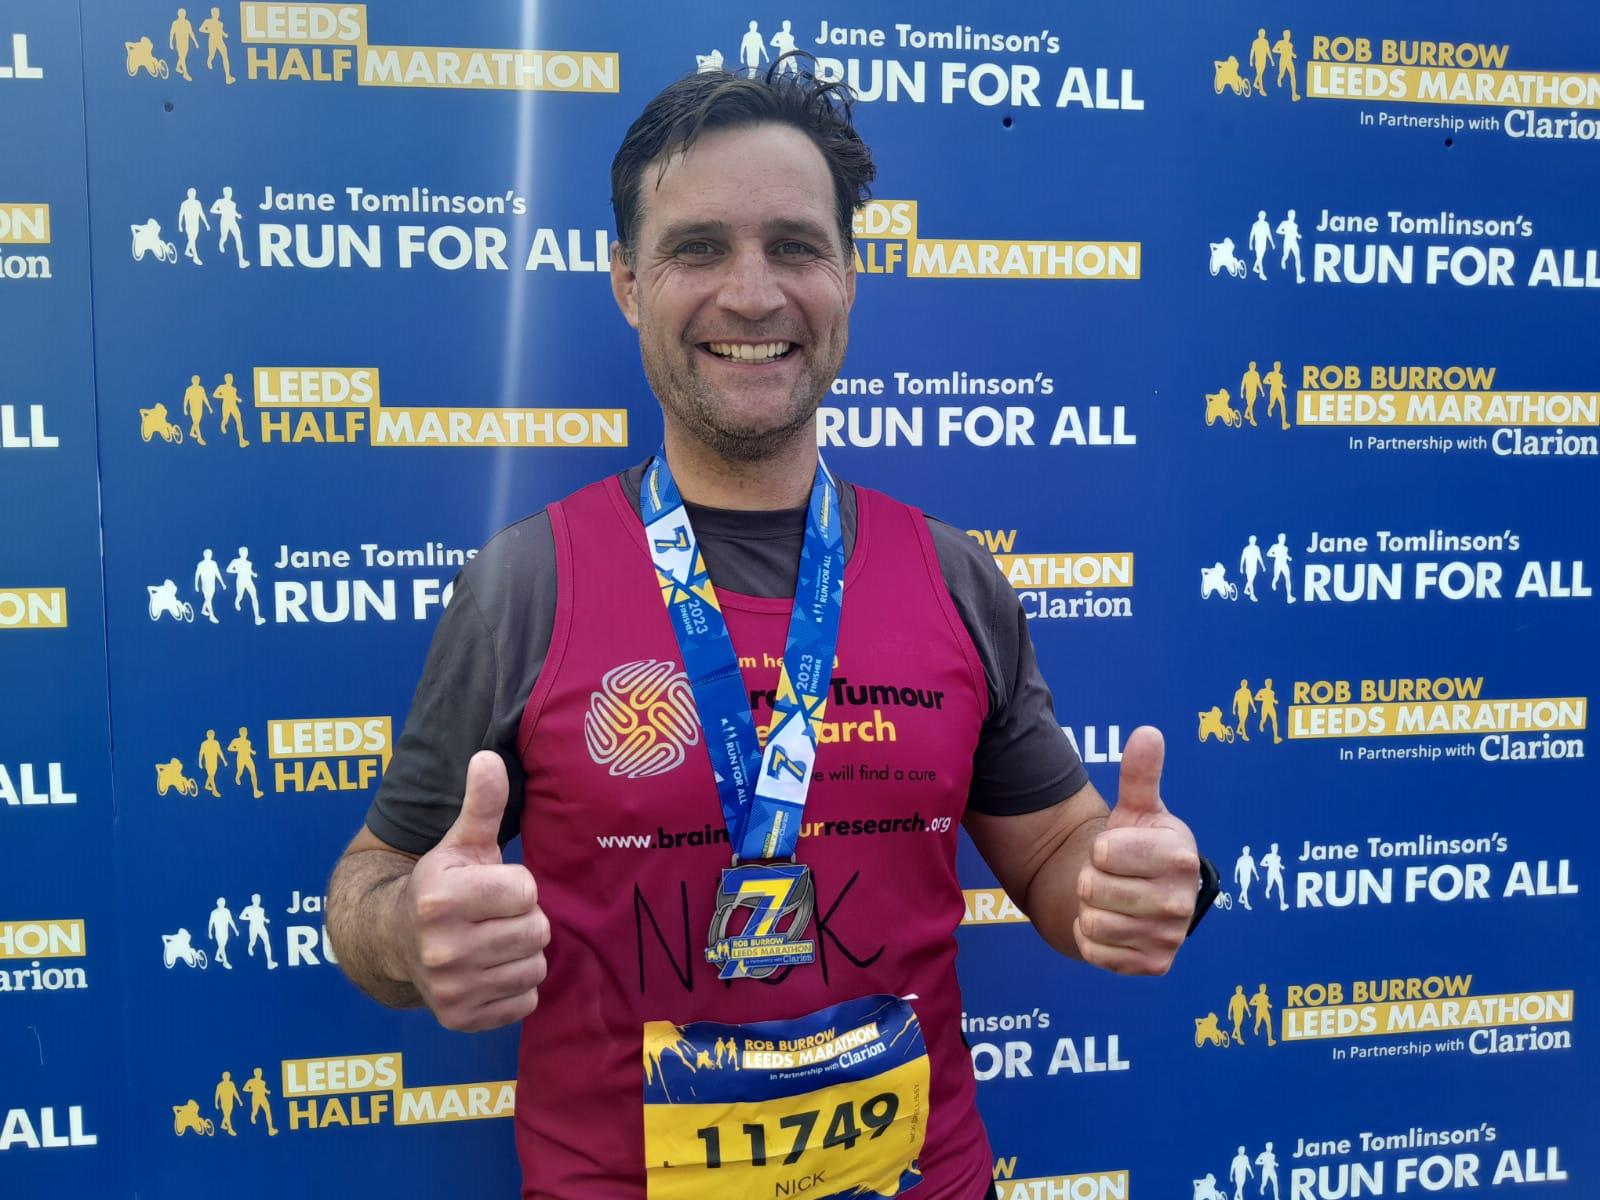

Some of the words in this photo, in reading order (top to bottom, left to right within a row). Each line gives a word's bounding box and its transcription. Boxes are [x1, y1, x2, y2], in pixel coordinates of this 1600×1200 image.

[246, 4, 360, 40] LEEDS
[815, 21, 885, 46] Jane
[896, 24, 1059, 53] Tomlinson's
[1313, 36, 1371, 62] ROB
[1382, 40, 1508, 68] BURROW
[248, 48, 351, 81] HALF
[363, 51, 614, 89] MARATHON
[815, 58, 925, 102] RUN
[942, 63, 1040, 106] FOR
[1056, 67, 1144, 110] ALL
[1314, 66, 1406, 98] LEEDS
[1361, 112, 1373, 124] In
[1379, 112, 1464, 132] Partnership
[1469, 117, 1499, 130] with
[259, 187, 335, 211] Jane
[346, 187, 527, 216] Tomlinson's
[1317, 210, 1378, 232] Jane
[1388, 212, 1532, 236] Tomlinson's
[259, 224, 381, 268] RUN
[399, 226, 508, 270] FOR
[525, 228, 612, 273] ALL
[913, 244, 1136, 275] MARATHON
[1314, 244, 1413, 283] RUN
[1427, 246, 1514, 285] FOR
[260, 371, 373, 403] LEEDS
[830, 377, 885, 396] ane
[894, 372, 1053, 394] Tomlinson's
[1303, 366, 1360, 389] ROB
[1371, 367, 1495, 390] BURROW
[1304, 395, 1395, 422] LEEDS
[1407, 395, 1596, 423] MARATHON
[1, 405, 58, 447] LL
[261, 412, 364, 442] HALF
[377, 412, 622, 443] MARATHON
[816, 406, 923, 448] RUN
[939, 406, 1034, 446] FOR
[1050, 406, 1136, 445] ALL
[1350, 437, 1362, 449] In
[1368, 436, 1452, 453] Partnership
[1457, 436, 1487, 449] with
[1492, 428, 1598, 455] Clarion
[275, 545, 350, 568] Jane
[1307, 532, 1367, 553] Jane
[1377, 530, 1519, 551] Tomlinson's
[993, 554, 1130, 586] ATHON
[1305, 564, 1401, 601] RUN
[1416, 562, 1502, 599] FOR
[1516, 561, 1592, 597] ALL
[275, 580, 395, 622] RUN
[412, 578, 454, 621] F
[1017, 590, 1133, 620] Clarion
[678, 603, 695, 636] FINISHER
[689, 600, 709, 634] 2023
[795, 653, 814, 691] 2023
[809, 658, 823, 694] FINISHER
[830, 677, 945, 710] Tumour
[1294, 681, 1351, 704] ROB
[1361, 678, 1483, 701] BURROW
[1295, 707, 1385, 735] LEEDS
[1394, 701, 1583, 732] MARATHON
[274, 720, 385, 754] LEEDS
[1341, 748, 1353, 760] In
[1358, 745, 1441, 761] Partnership
[1446, 743, 1475, 756] with
[1480, 733, 1584, 761] Clarion
[274, 761, 377, 793] HALF
[828, 765, 854, 781] will
[859, 764, 890, 781] find
[893, 769, 904, 781] a
[907, 769, 936, 782] cure
[1299, 841, 1358, 861] Jane
[1368, 833, 1507, 857] Tomlinson's
[1297, 868, 1392, 908] RUN
[1406, 864, 1490, 902] FOR
[1503, 860, 1578, 897] ALL
[285, 889, 328, 914] Ja
[633, 870, 886, 995] NK
[719, 865, 807, 978] 7
[732, 940, 749, 948] ROB
[750, 938, 785, 946] BURROW
[733, 949, 759, 958] LEEDS
[760, 943, 813, 955] MARATHON
[783, 954, 814, 963] Clarion
[1288, 983, 1343, 1007] ROB
[1351, 975, 1473, 1003] BURROW
[1289, 1006, 1376, 1038] LEEDS
[1388, 994, 1570, 1031] MARATHON
[744, 1039, 775, 1051] ROB
[779, 1026, 836, 1051] BURROW
[745, 1052, 793, 1067] LEEDS
[798, 1024, 877, 1065] MARATHON
[1333, 1048, 1345, 1059] In
[1350, 1042, 1431, 1060] Partnership
[1435, 1038, 1464, 1052] with
[1469, 1026, 1571, 1054] Clarion
[779, 1067, 823, 1079] Partnership
[824, 1063, 839, 1071] with
[838, 1041, 886, 1069] Clarion
[972, 1041, 1033, 1081] OR
[1048, 1035, 1129, 1075] ALL
[288, 1057, 396, 1092] LEEDS
[289, 1095, 388, 1129] HALF
[399, 1085, 516, 1122] MARA
[0, 1106, 97, 1150] ALL
[697, 1092, 899, 1168] 11749
[1293, 1139, 1351, 1158] Jane
[1360, 1123, 1496, 1151] Tomlinson's
[775, 1170, 825, 1198] NICK
[996, 1174, 1125, 1200] ATHON
[1291, 1161, 1383, 1200] RUN
[1397, 1154, 1479, 1192] FOR
[1492, 1147, 1567, 1184] ALL
